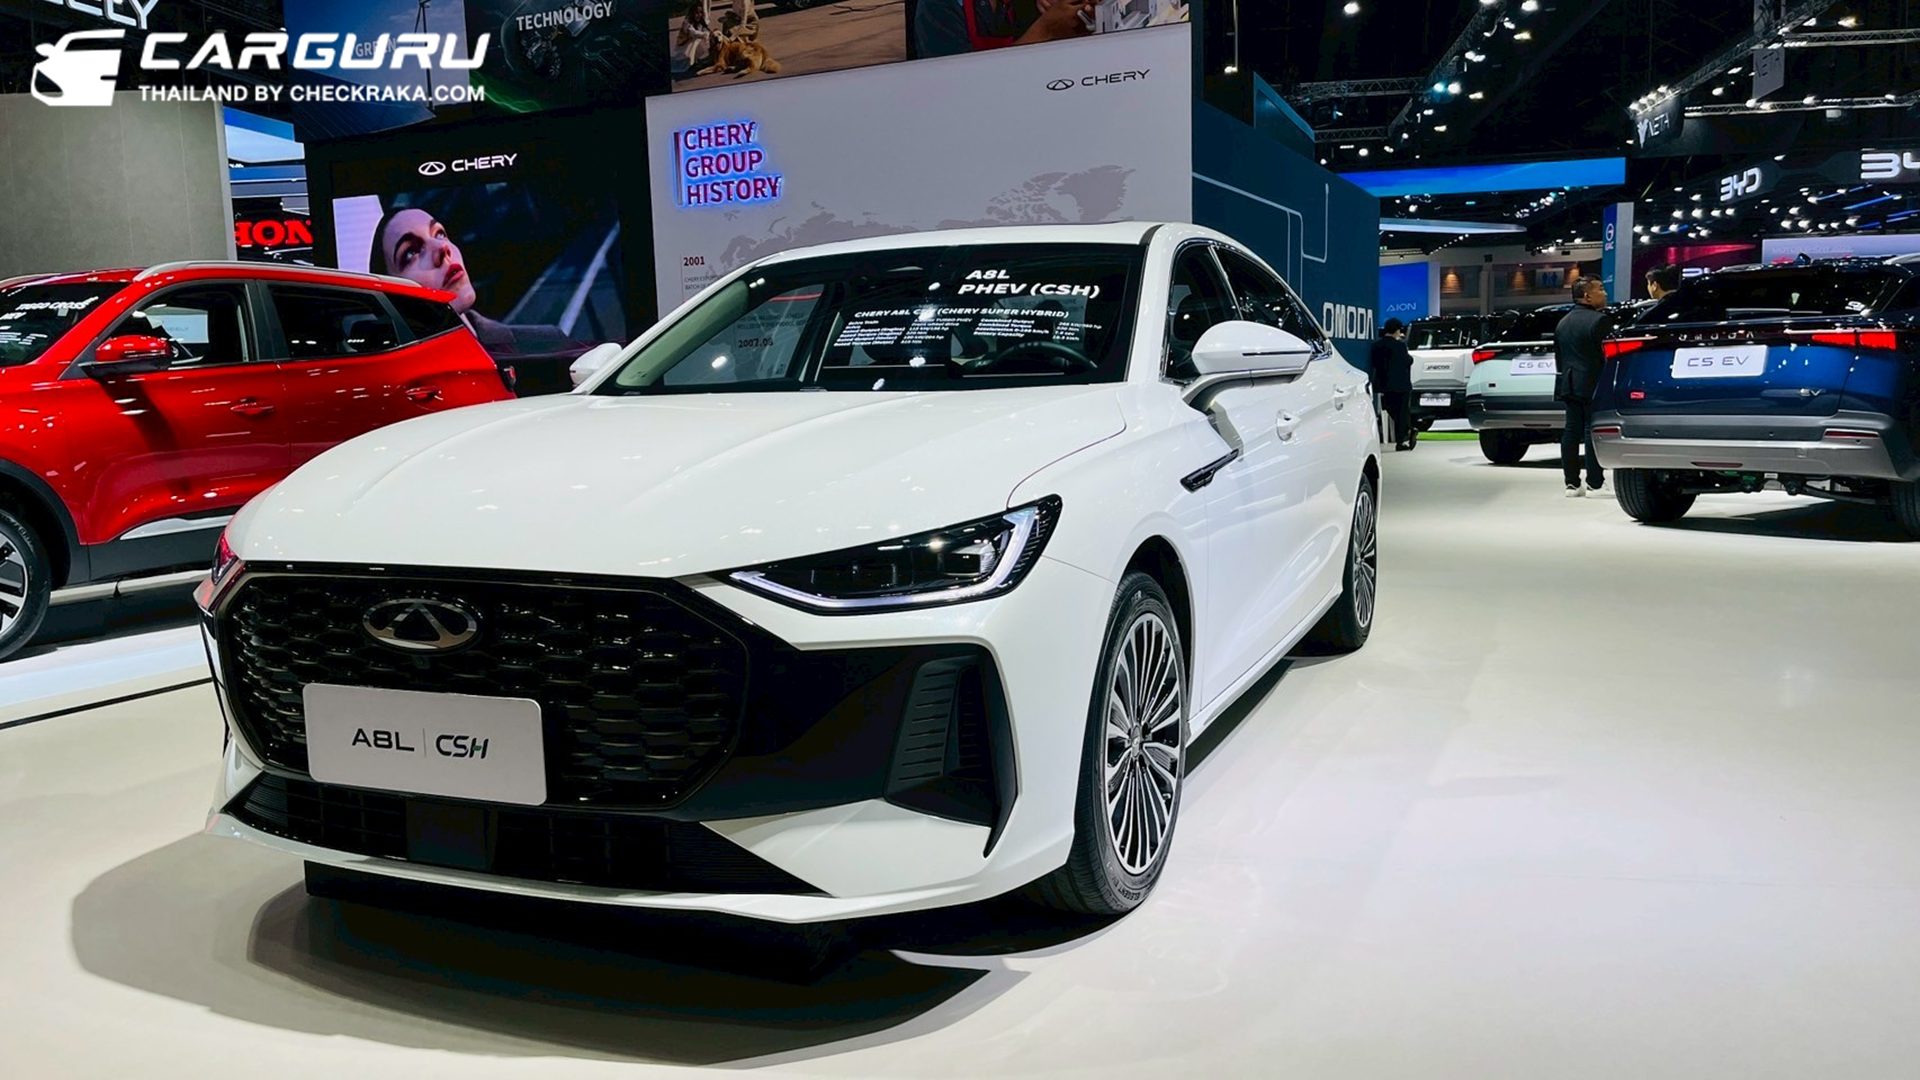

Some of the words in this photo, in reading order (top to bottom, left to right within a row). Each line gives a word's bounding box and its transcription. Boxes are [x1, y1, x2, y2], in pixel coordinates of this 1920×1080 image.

[516, 1, 612, 31] TECHNOLOGY
[355, 37, 396, 57] GRN
[1081, 69, 1151, 87] CHERY
[684, 121, 756, 150] CHERY
[451, 153, 518, 172] CHERY
[685, 150, 763, 178] GROUP
[687, 176, 782, 205] HISTORY
[1720, 167, 1762, 202] BYD
[683, 255, 706, 267] 2001
[965, 269, 1010, 280] A8L
[957, 283, 1028, 295] PHEV
[1030, 282, 1100, 299] (CSH)
[854, 310, 891, 318] CHERY
[1021, 309, 1070, 319] HYBRID)
[1386, 303, 1417, 312] AION
[1322, 302, 1375, 340] OMODA
[1721, 356, 1751, 366] EV
[351, 728, 415, 752] A8L
[435, 734, 489, 760] CSH
